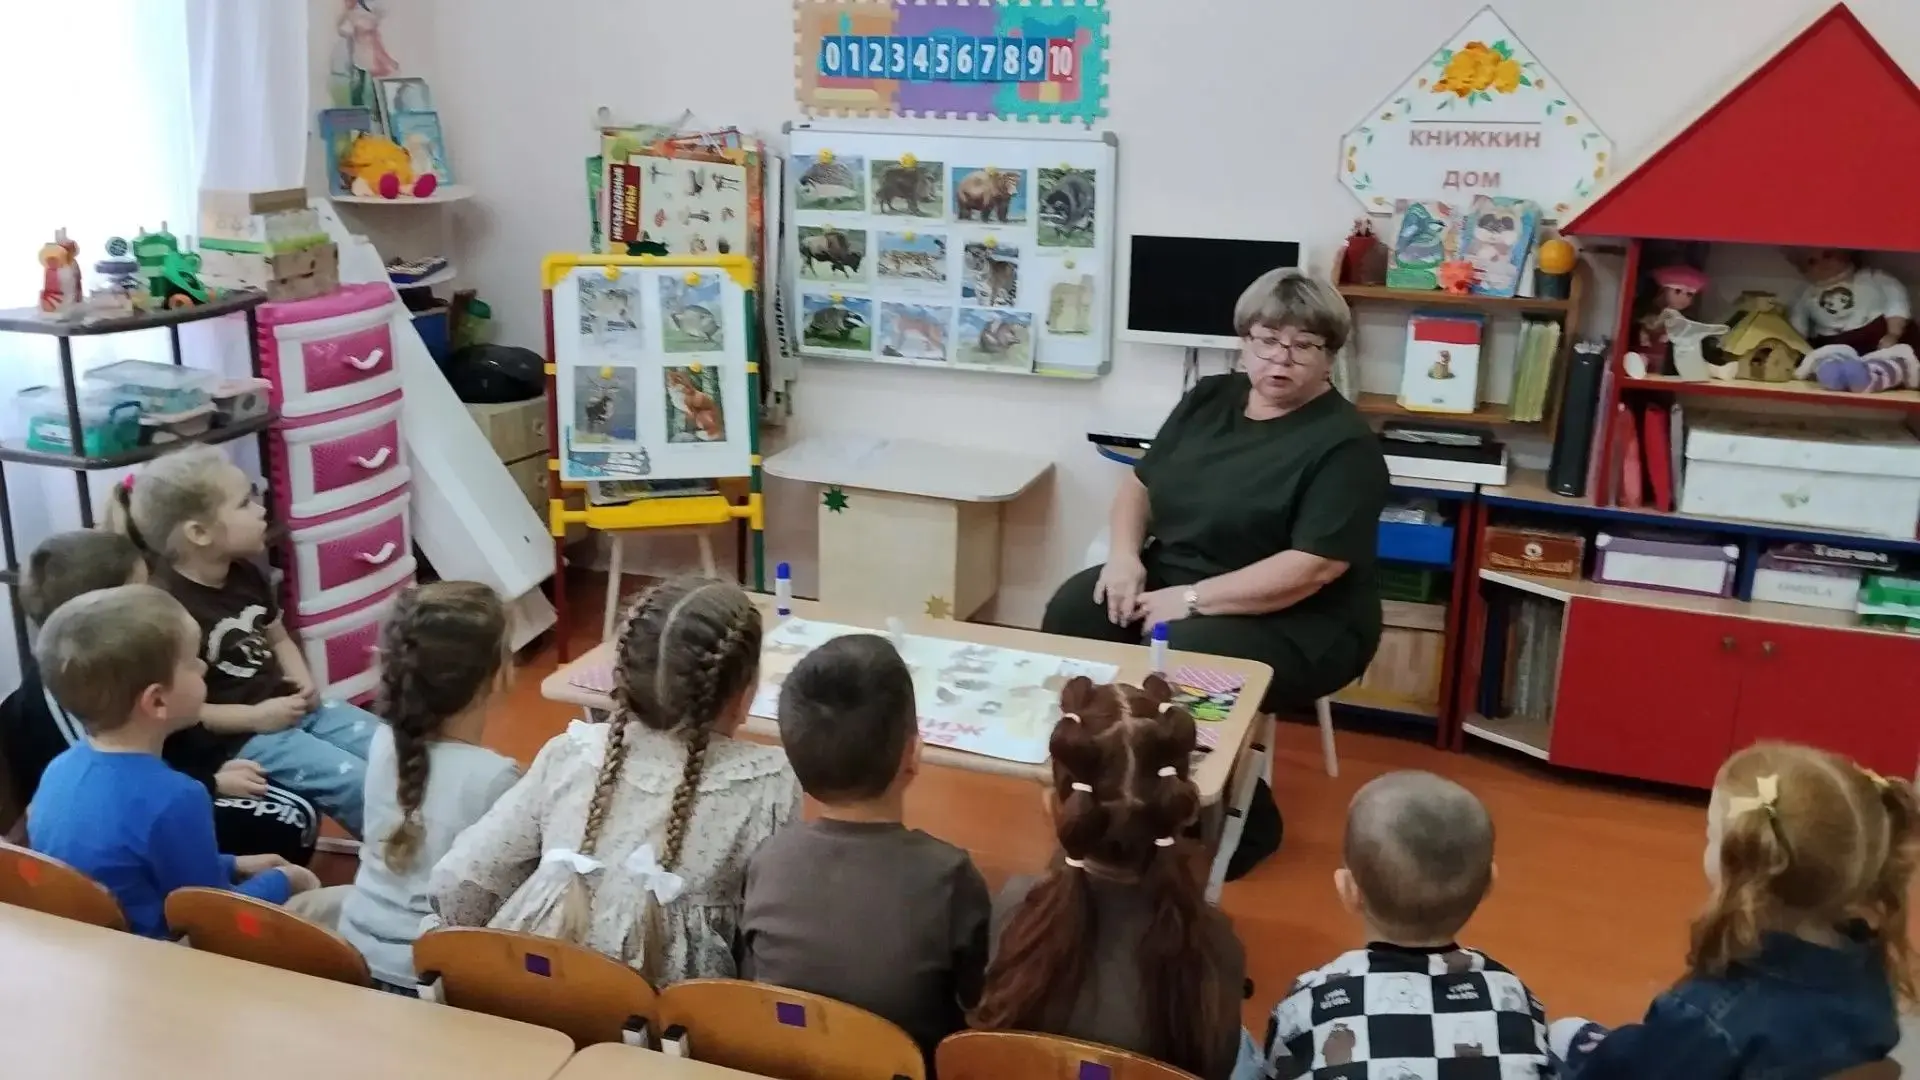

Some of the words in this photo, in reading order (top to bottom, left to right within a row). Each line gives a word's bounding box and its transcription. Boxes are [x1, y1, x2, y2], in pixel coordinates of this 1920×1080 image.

[825, 42, 841, 71] 0
[847, 43, 860, 72] 1
[868, 43, 884, 72] 2
[891, 43, 906, 72] 3
[913, 44, 929, 73] 4
[935, 43, 950, 74] 5
[957, 44, 973, 74] 6
[981, 45, 996, 74] 7
[1003, 45, 1020, 75] 8
[1027, 45, 1044, 75] 9
[1050, 45, 1073, 76] 10
[1409, 130, 1541, 149] КНИЖКИН
[1443, 170, 1500, 189] ДОМ
[625, 185, 638, 225] ГРИБЫ
